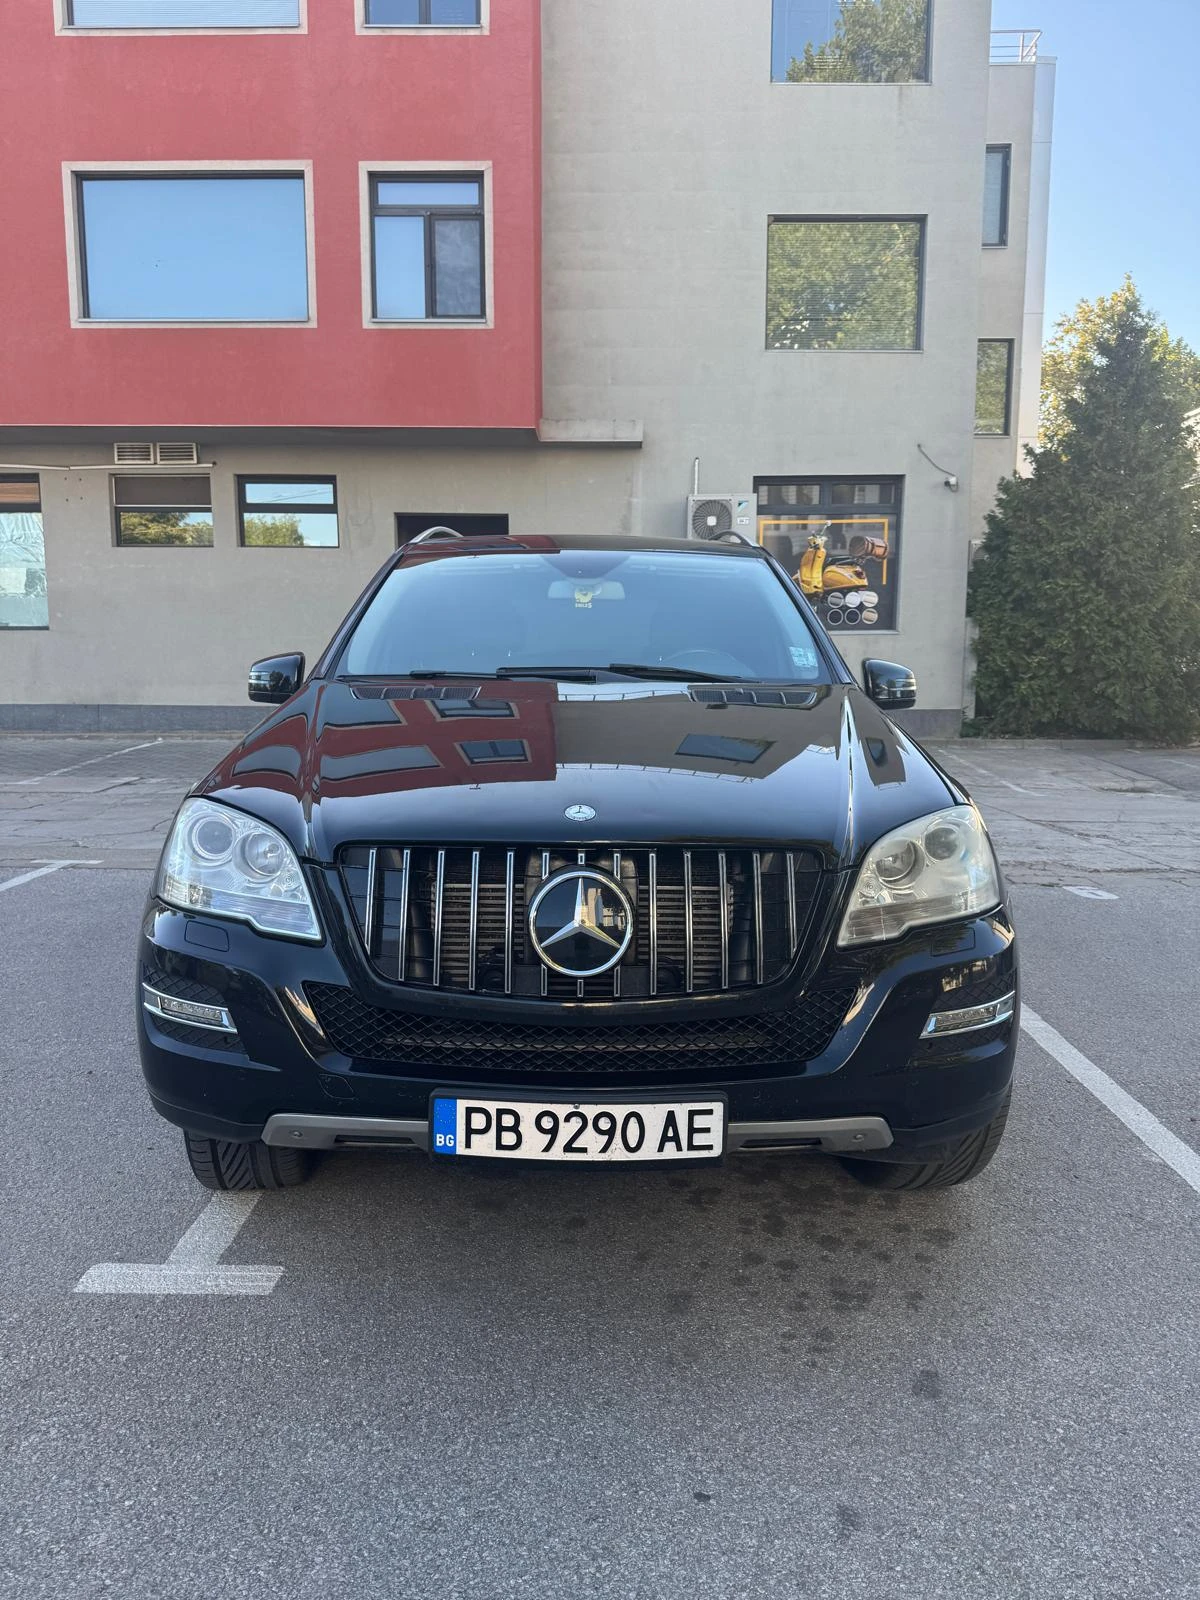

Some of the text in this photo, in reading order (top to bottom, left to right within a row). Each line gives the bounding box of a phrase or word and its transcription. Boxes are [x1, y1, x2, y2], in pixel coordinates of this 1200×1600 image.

[435, 1134, 454, 1147] BG
[465, 1106, 713, 1153] PB 9290 AE
